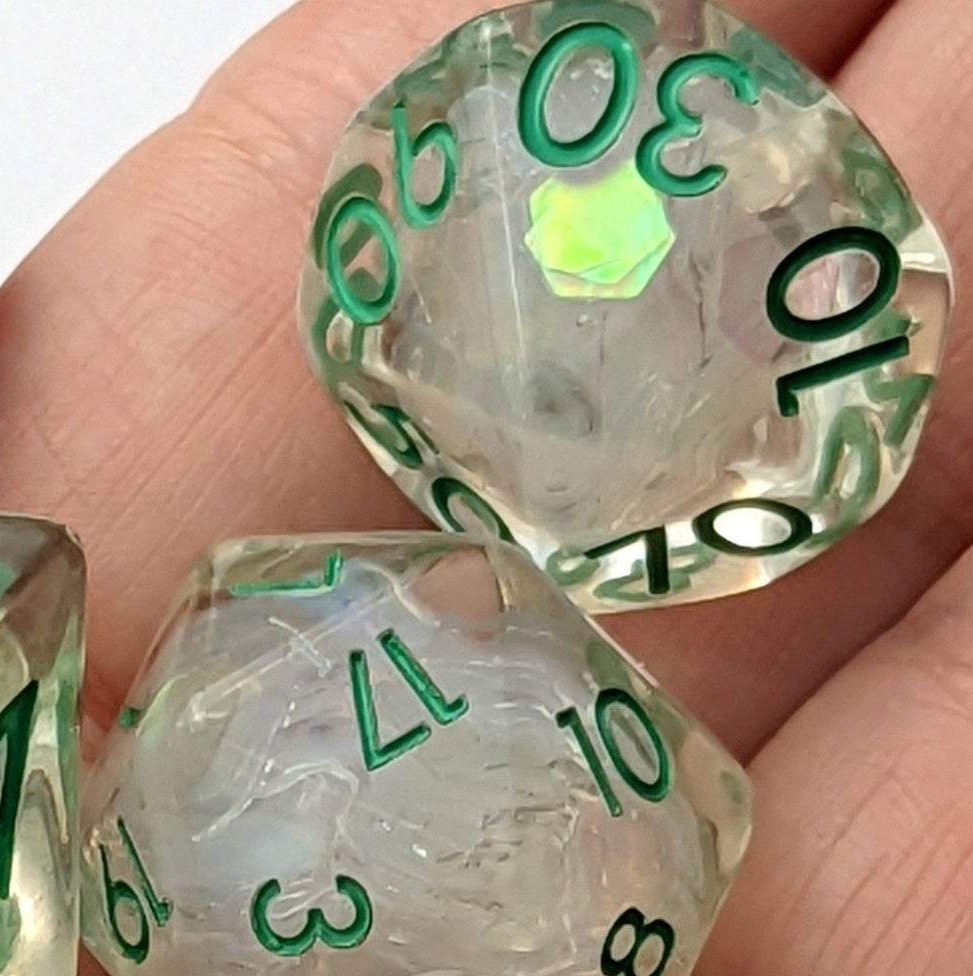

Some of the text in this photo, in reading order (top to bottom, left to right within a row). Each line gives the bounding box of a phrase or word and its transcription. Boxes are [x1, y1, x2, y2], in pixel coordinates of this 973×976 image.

[348, 629, 468, 771] 17
[556, 687, 675, 816] 10
[249, 875, 373, 958] 3
